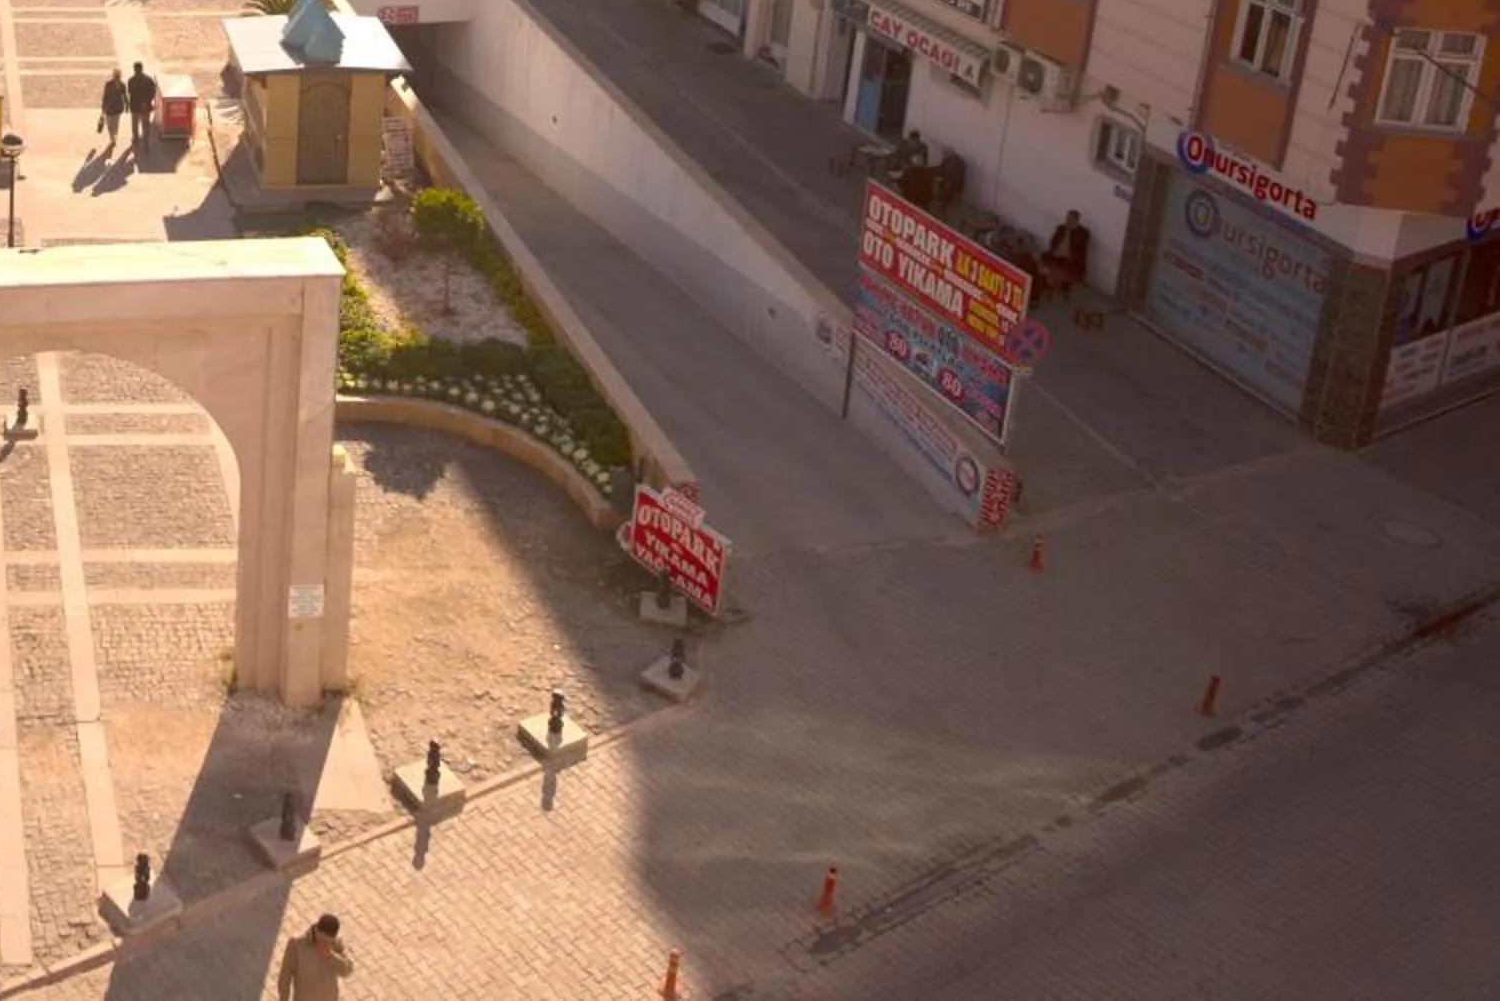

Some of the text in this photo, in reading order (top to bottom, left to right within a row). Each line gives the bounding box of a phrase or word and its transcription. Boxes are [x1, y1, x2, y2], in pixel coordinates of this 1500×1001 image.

[869, 195, 956, 269] OTOPARK
[864, 230, 894, 269] OTO
[898, 252, 965, 318] YIKAMA
[638, 503, 721, 579] OTOPARK
[645, 529, 709, 588] YIKAMA
